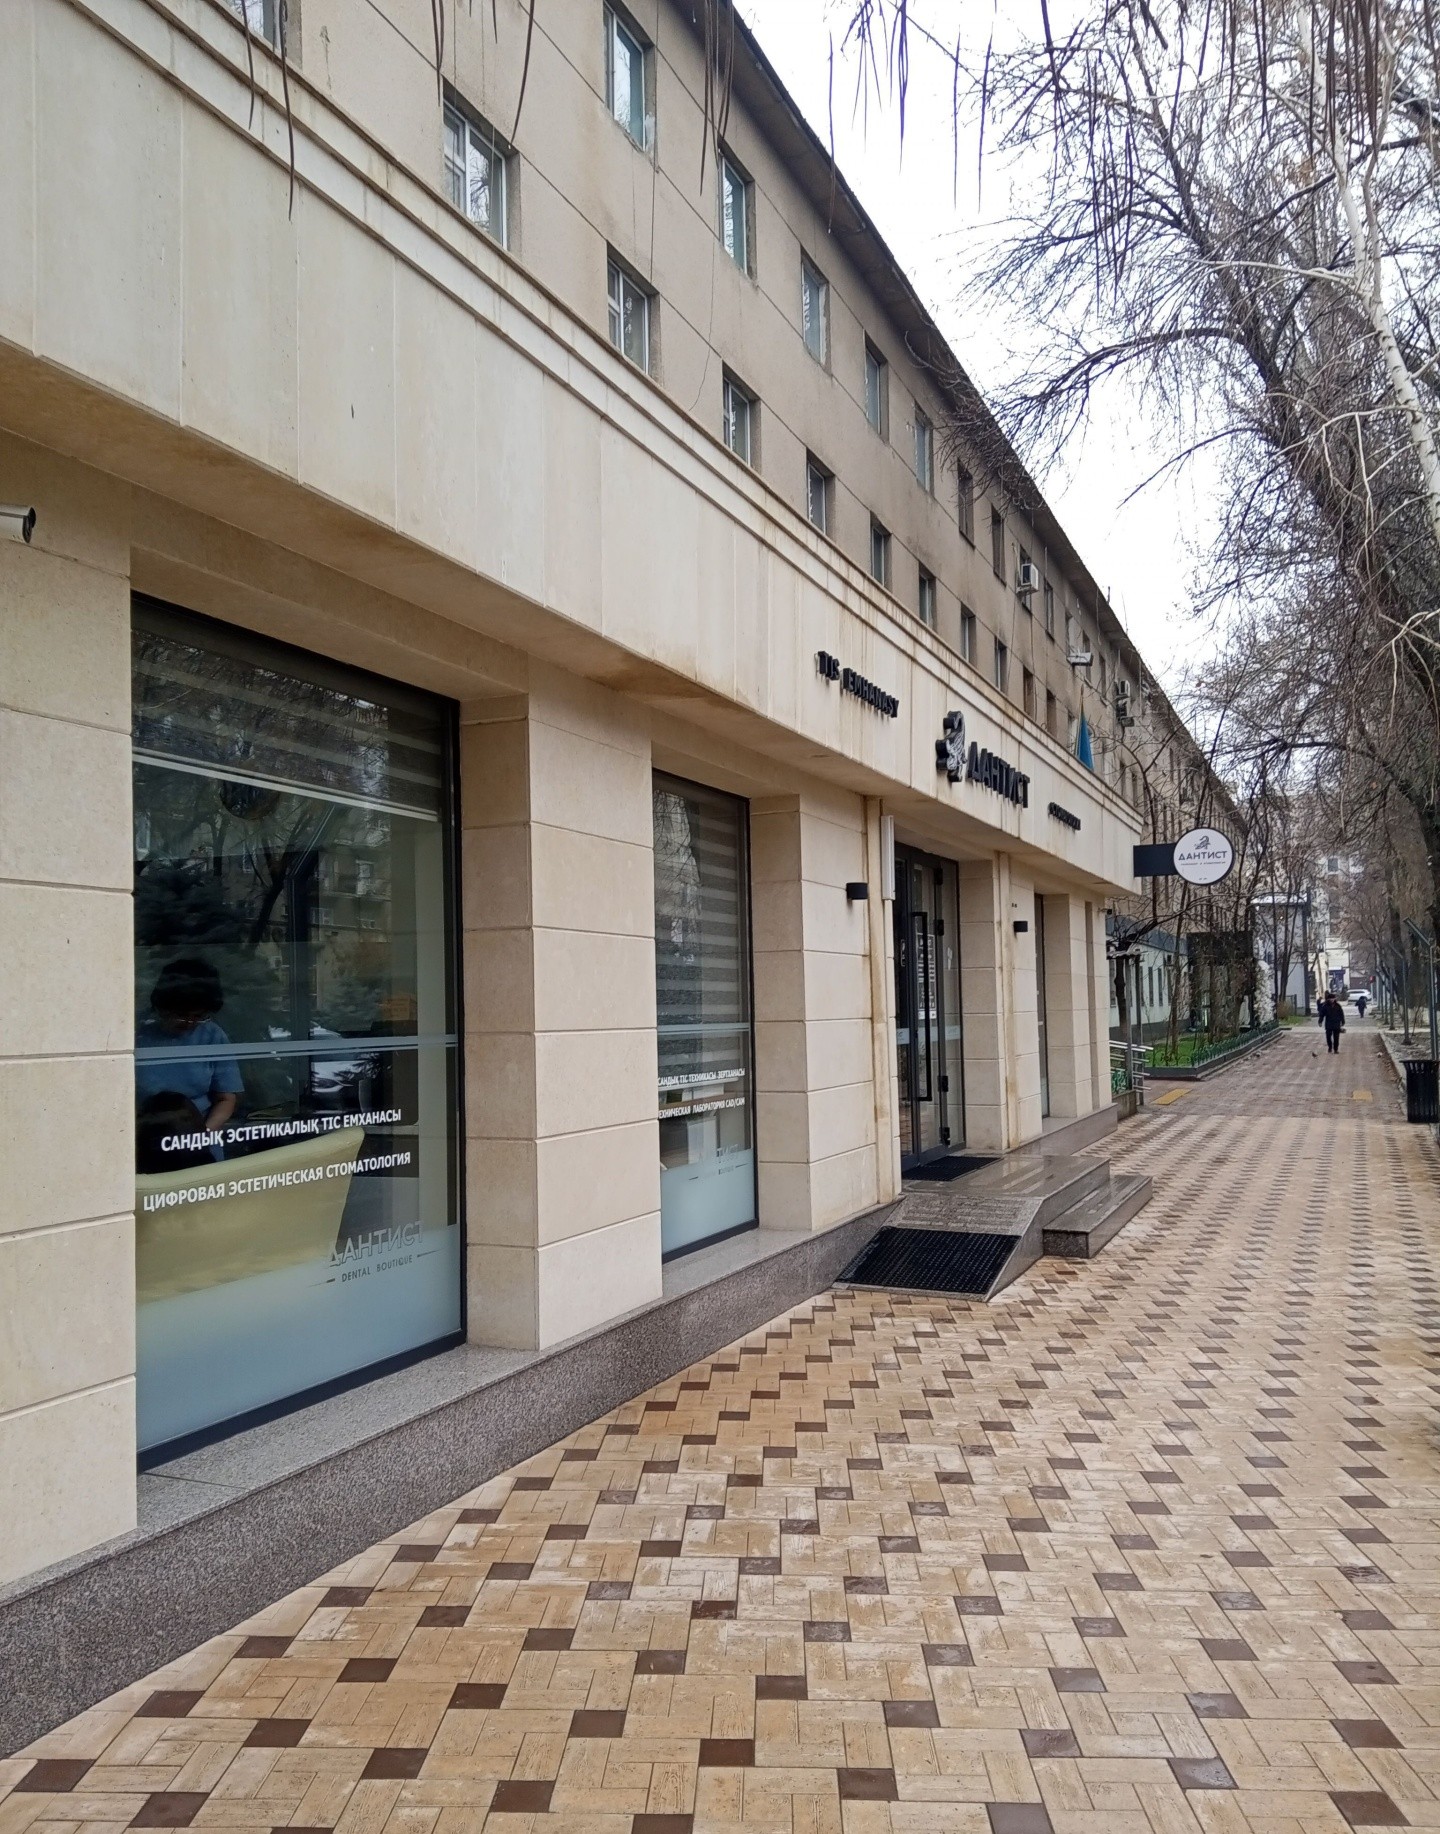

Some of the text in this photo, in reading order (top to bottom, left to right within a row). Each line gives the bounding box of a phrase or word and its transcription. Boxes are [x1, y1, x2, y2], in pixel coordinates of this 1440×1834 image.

[842, 667, 899, 718] EMHANASY
[967, 741, 1030, 808] ДАНТИСТ
[1178, 850, 1227, 861] ДАНТИСТ
[693, 1100, 725, 1113] ЛАБОРАТОРИЯ
[161, 1109, 402, 1152] САНДЫҚ ЭСТЕТИКАЛЫҚ ТІС ЕМХАНАСЫ
[143, 1151, 412, 1213] ЦИФРОВАЯ ЭСТЕТИЧЕСКАЯ СТОМАТОЛОГИЯ
[341, 1254, 413, 1283] DENTAL BOUTIQUE
